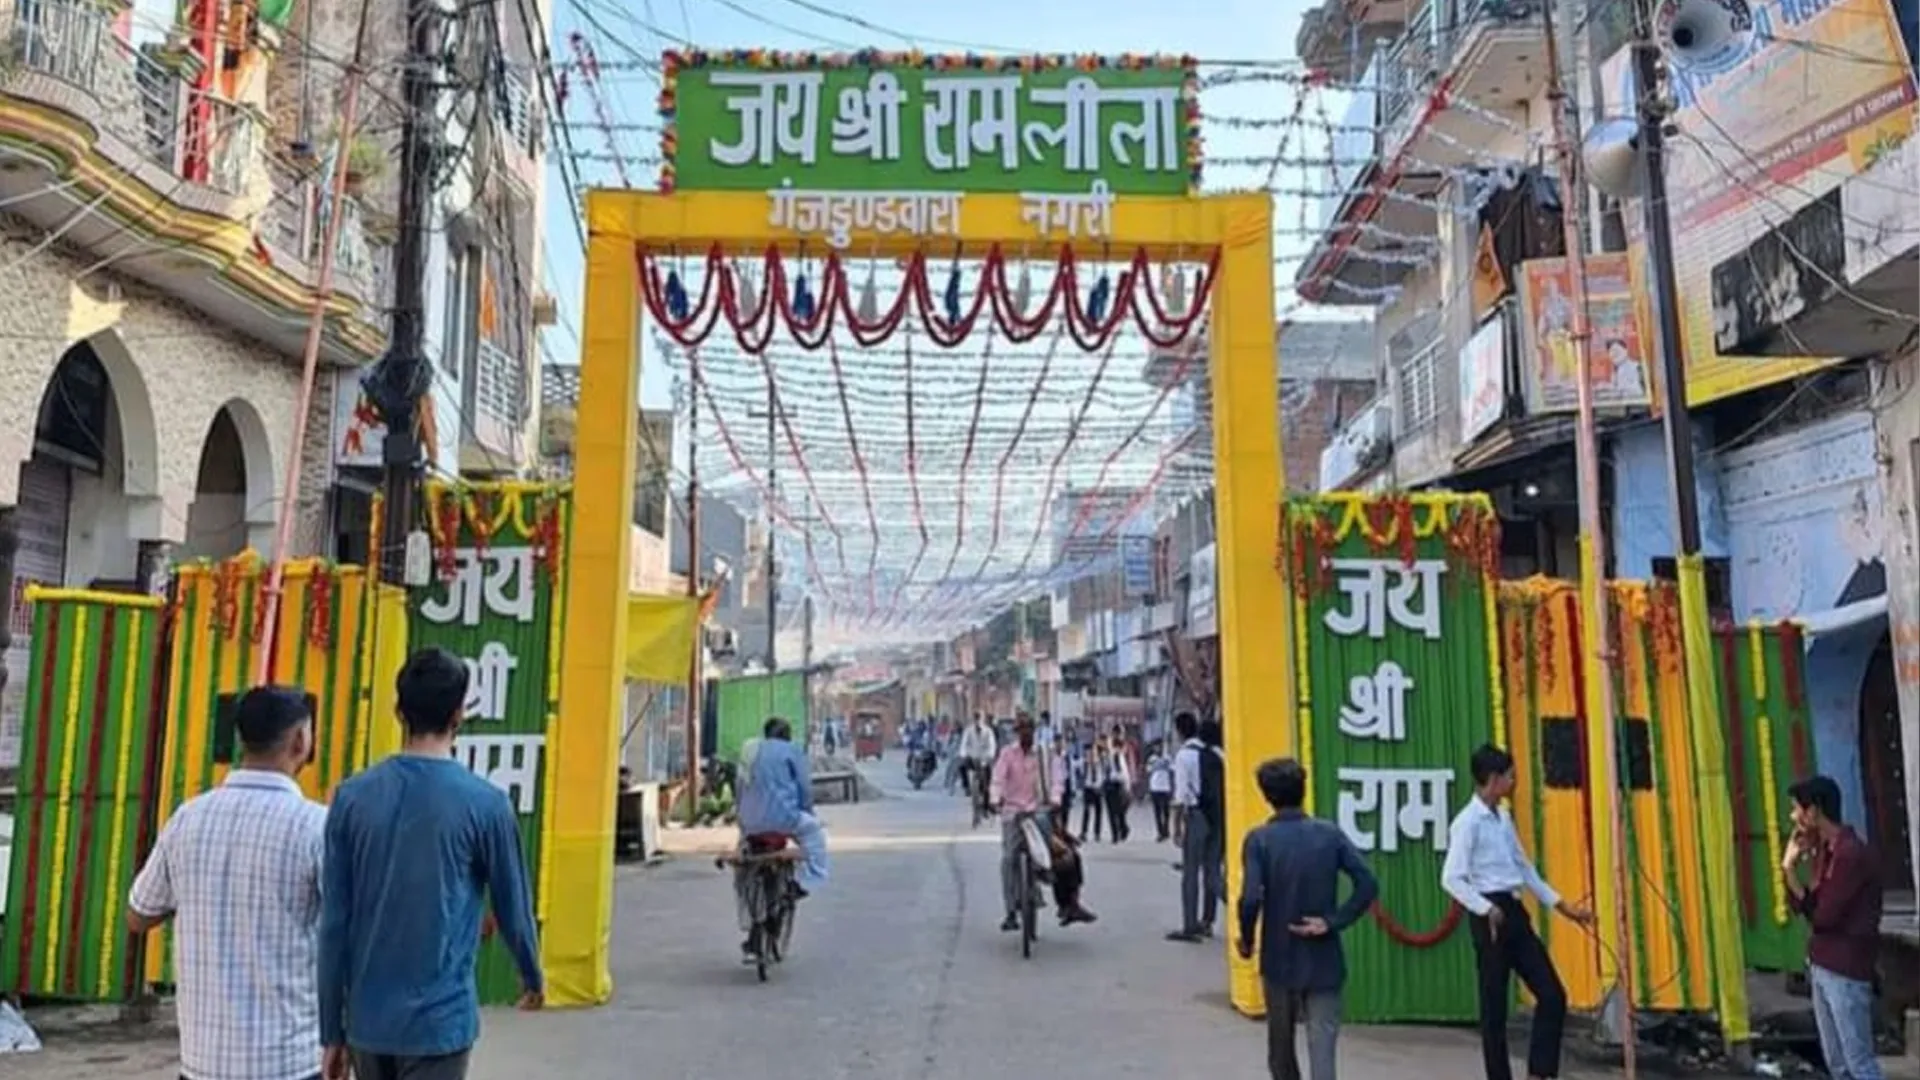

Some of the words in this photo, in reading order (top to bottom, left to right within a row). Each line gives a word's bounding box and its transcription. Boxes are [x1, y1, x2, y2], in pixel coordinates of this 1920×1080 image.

[710, 71, 823, 166] जय
[832, 72, 907, 160] श्री
[1020, 178, 1115, 237] नगरी
[420, 546, 545, 626] जय
[1323, 558, 1448, 639] जय
[1339, 660, 1414, 740] श्री
[1337, 768, 1455, 851] राम
